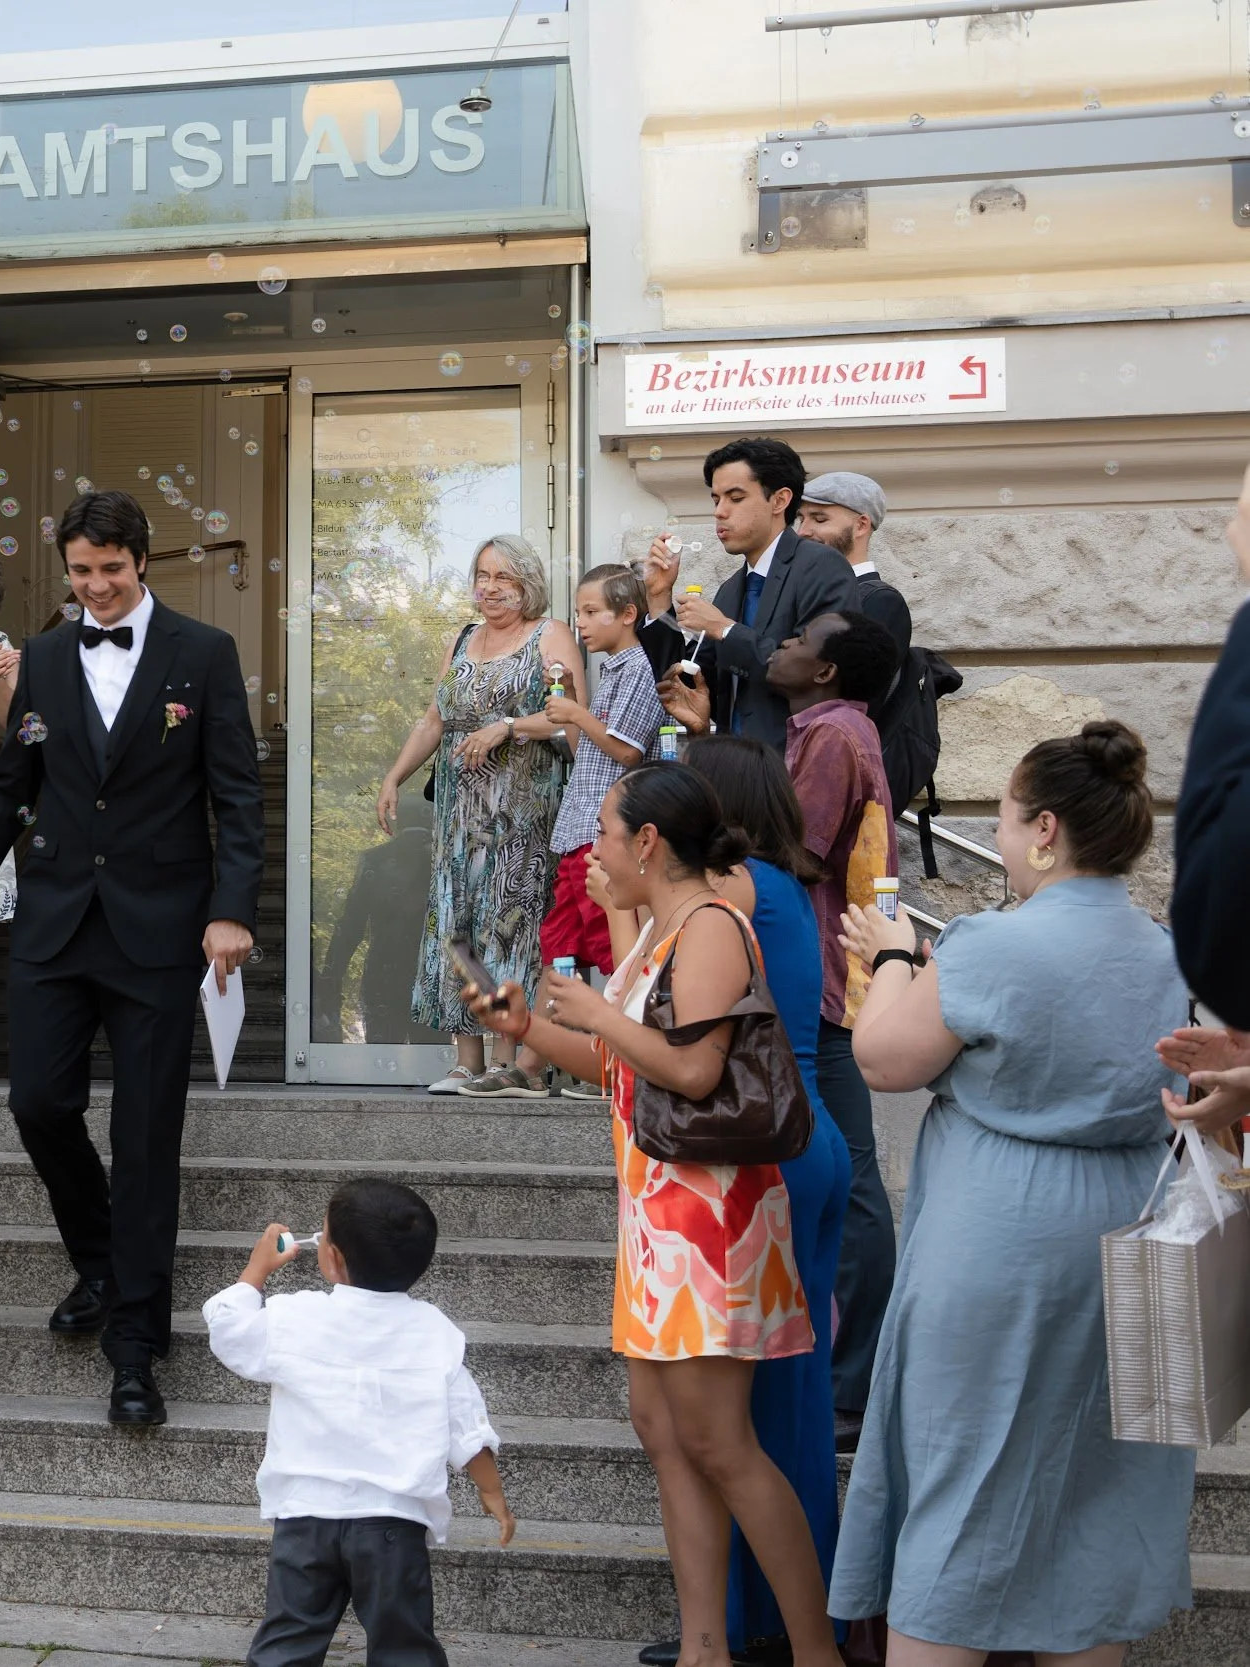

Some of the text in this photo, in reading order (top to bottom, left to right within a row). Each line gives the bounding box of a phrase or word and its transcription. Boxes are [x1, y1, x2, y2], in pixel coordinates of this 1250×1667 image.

[646, 358, 926, 392] Bezirksmuseum
[645, 389, 926, 415] an der Hinterseite des Amtshauses
